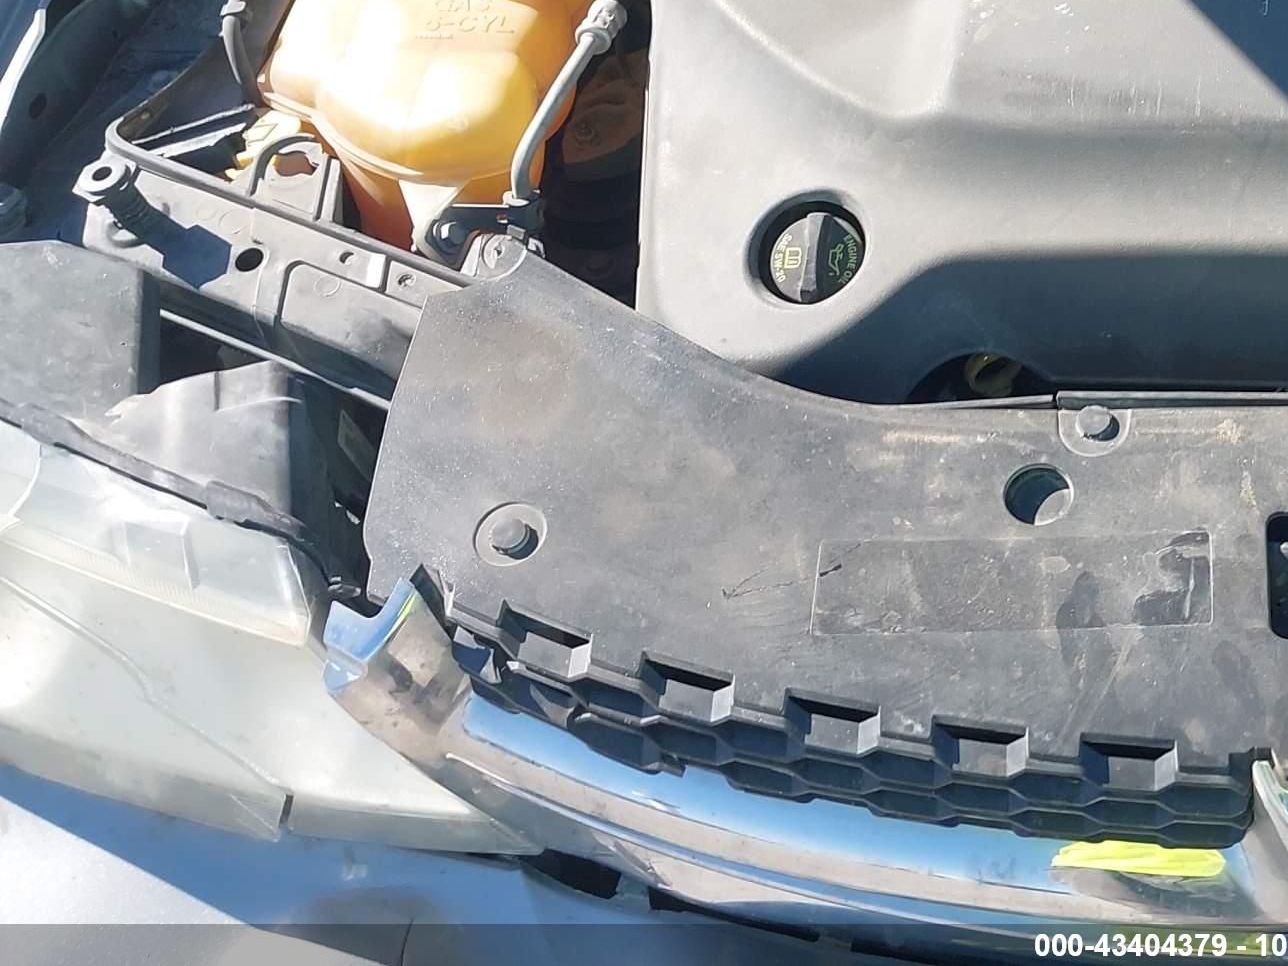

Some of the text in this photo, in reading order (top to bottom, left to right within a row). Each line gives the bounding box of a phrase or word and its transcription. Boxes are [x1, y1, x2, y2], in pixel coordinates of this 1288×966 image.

[425, 15, 515, 33] 6-CYL
[776, 233, 793, 253] SAE
[838, 234, 858, 284] ENGINE OIL
